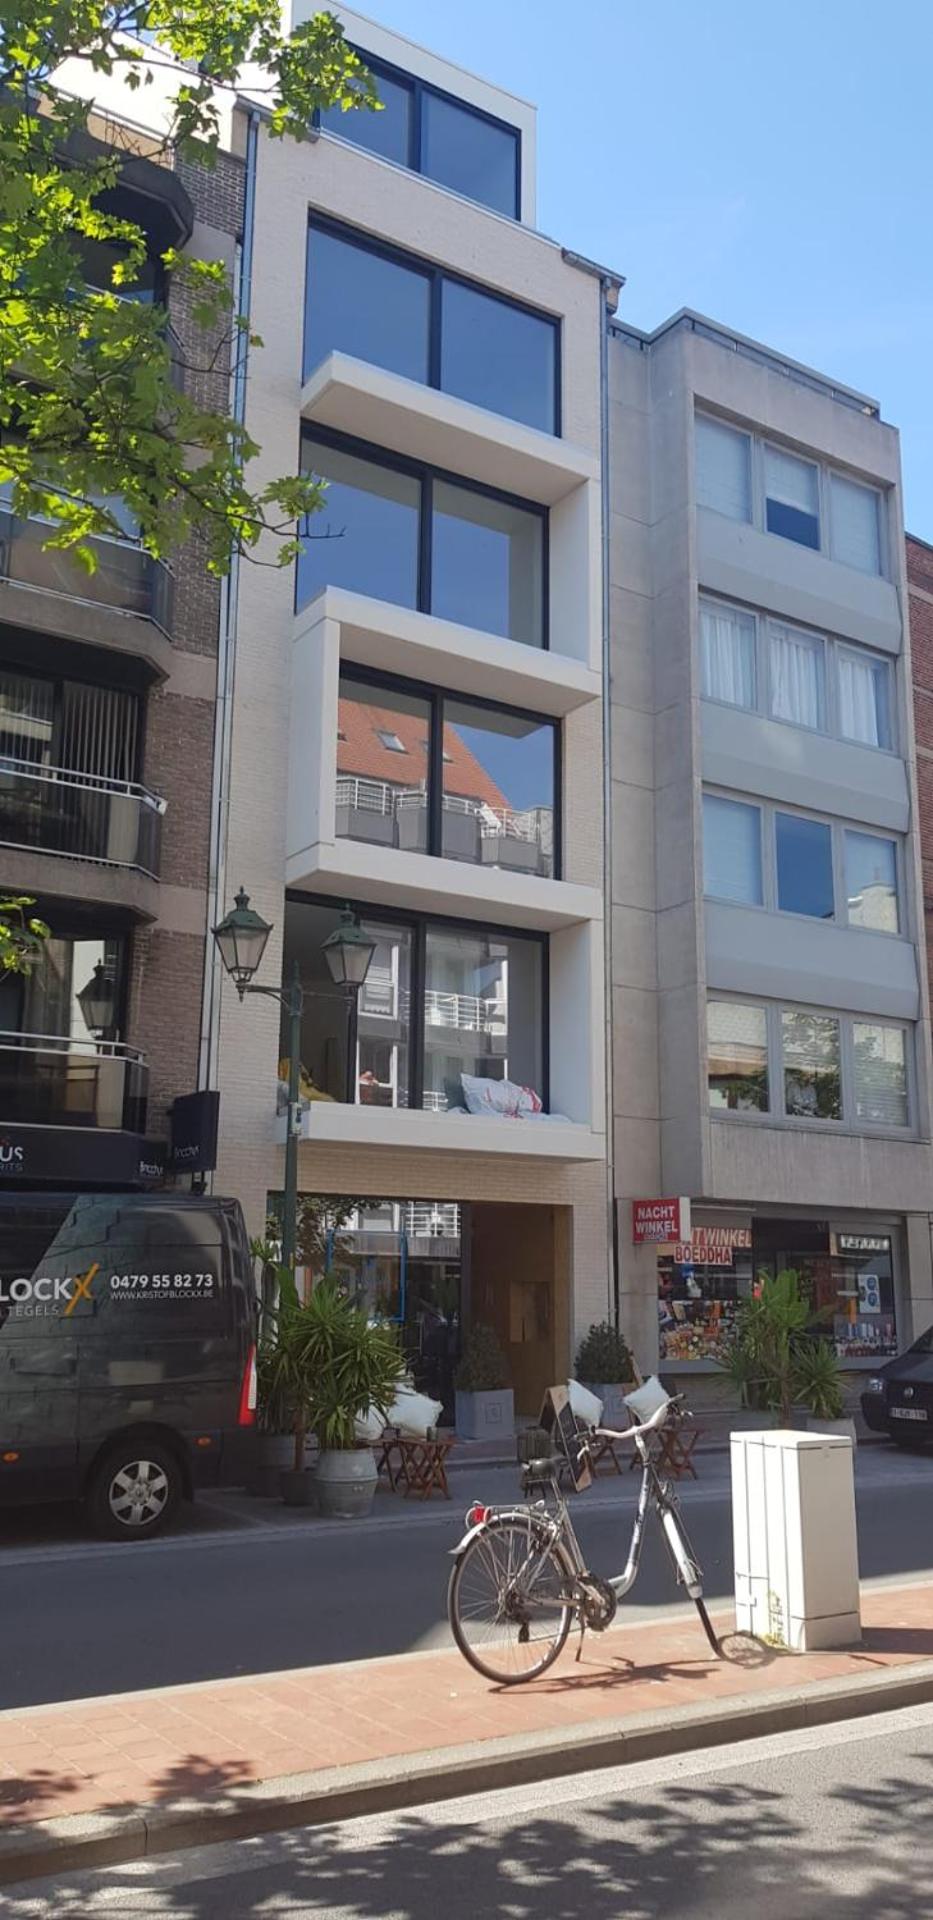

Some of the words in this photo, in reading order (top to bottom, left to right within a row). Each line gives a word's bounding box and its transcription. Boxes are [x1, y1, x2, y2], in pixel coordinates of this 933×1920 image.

[638, 1206, 675, 1219] NACHT
[635, 1220, 678, 1233] WINKEL
[675, 1246, 731, 1263] BOEDDHA
[110, 1275, 149, 1289] 0479
[152, 1274, 170, 1288] 55
[174, 1274, 192, 1287] 82
[195, 1274, 213, 1287] 73
[8, 1304, 60, 1317] TEGELS
